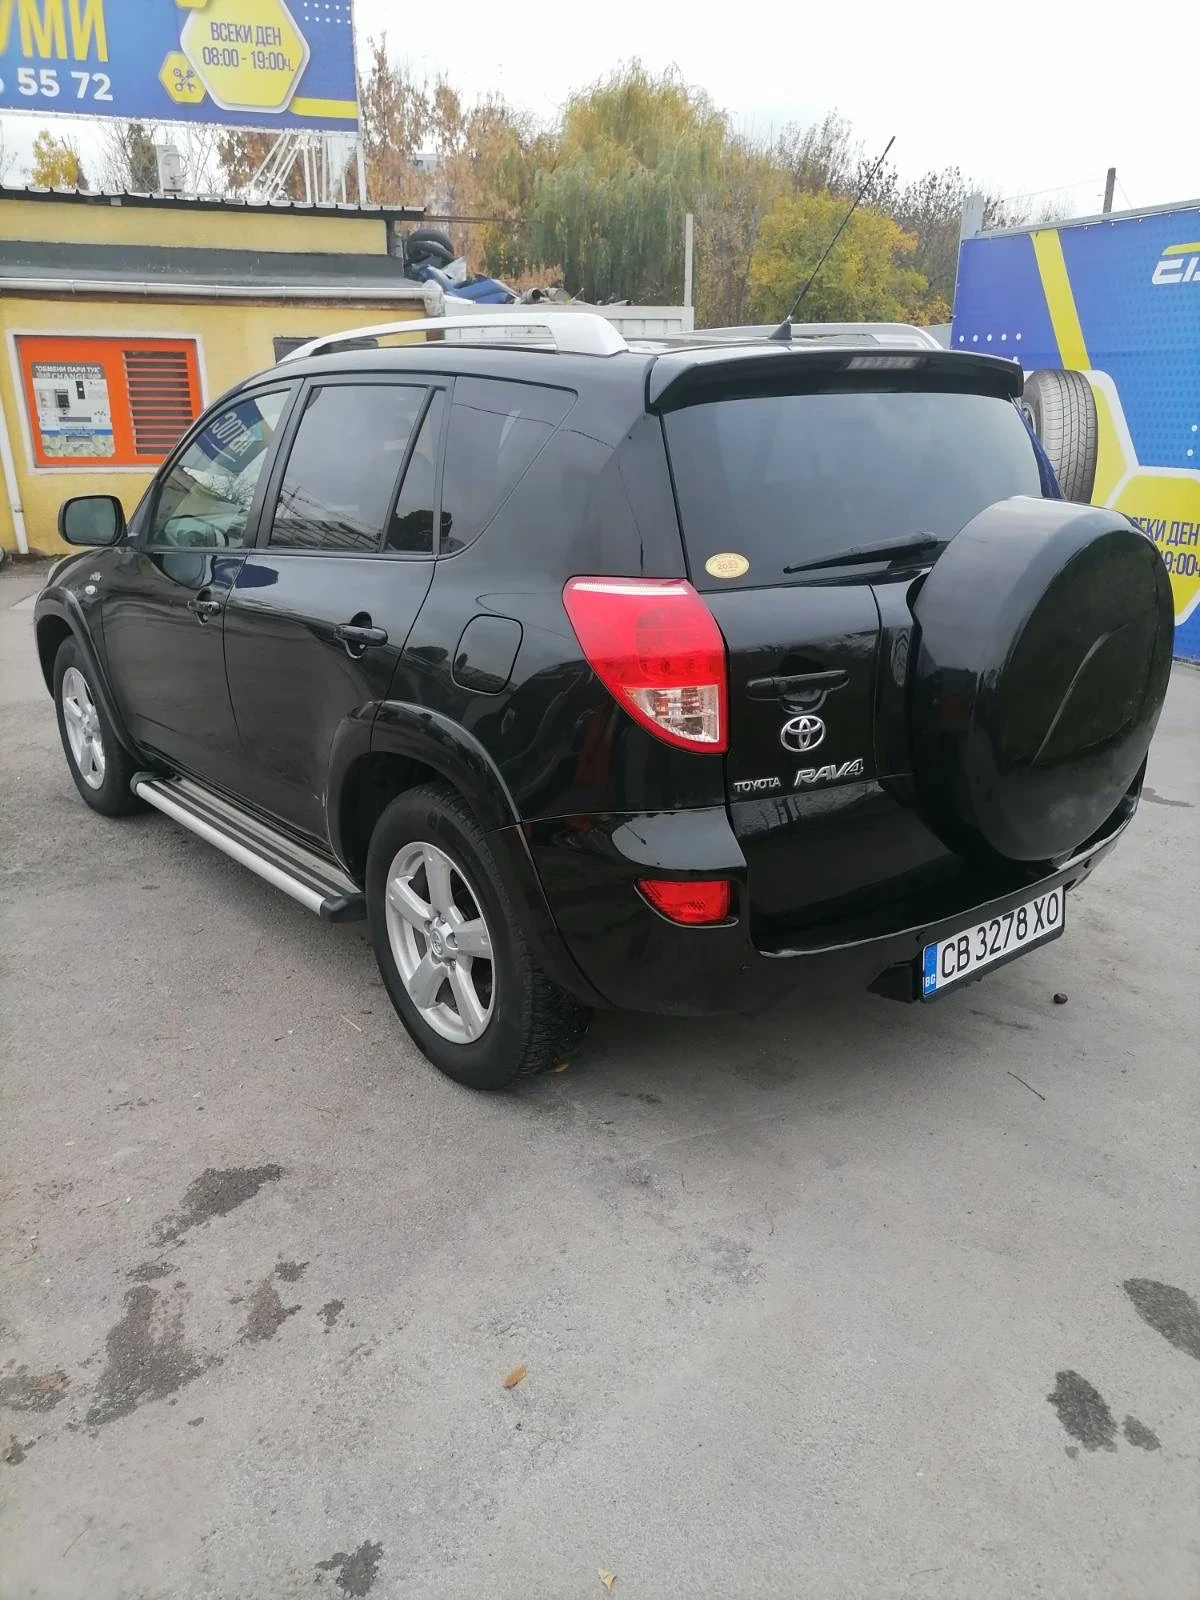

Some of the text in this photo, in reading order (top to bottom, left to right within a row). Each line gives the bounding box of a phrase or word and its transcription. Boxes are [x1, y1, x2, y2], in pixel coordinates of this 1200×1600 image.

[210, 22, 282, 47] ВСЕКИ ДЕН
[202, 46, 240, 68] 08:00
[17, 67, 60, 97] 55
[70, 71, 114, 101] 72
[1166, 521, 1200, 547] ДЕН
[733, 777, 781, 793] TOYOTA
[793, 758, 864, 787] RAV4
[941, 892, 1059, 979] CB 3278 XO
[925, 973, 936, 988] BG
